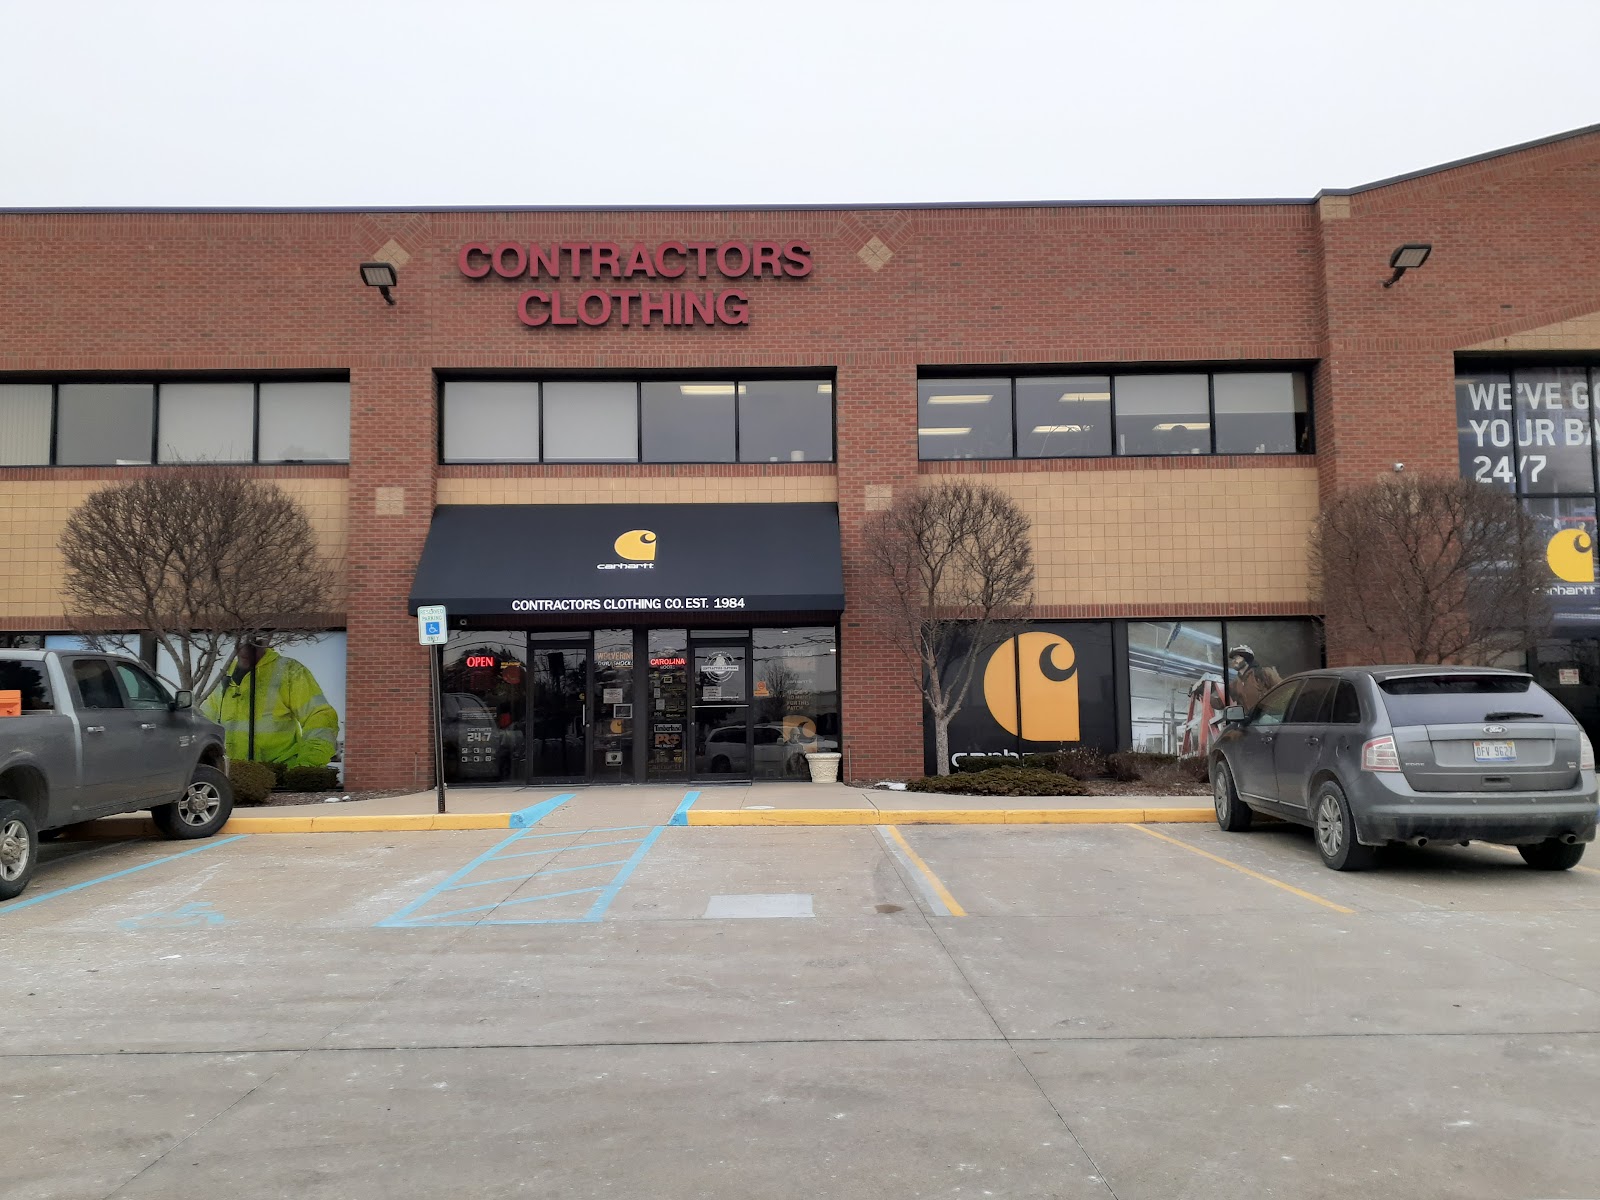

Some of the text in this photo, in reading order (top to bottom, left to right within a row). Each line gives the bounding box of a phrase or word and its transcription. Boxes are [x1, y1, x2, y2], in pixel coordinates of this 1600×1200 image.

[458, 240, 813, 279] CONTRACTORS
[517, 288, 749, 327] CLOTHING
[1468, 382, 1563, 411] WE'VE
[1469, 418, 1556, 448] YOUR
[1473, 454, 1547, 484] 24/7
[597, 562, 654, 570] carhartt
[511, 596, 746, 611] CONTRACTORS CLOTHING CO. EST. 1984
[466, 656, 494, 668] OPEN
[650, 658, 686, 666] CAROLINA
